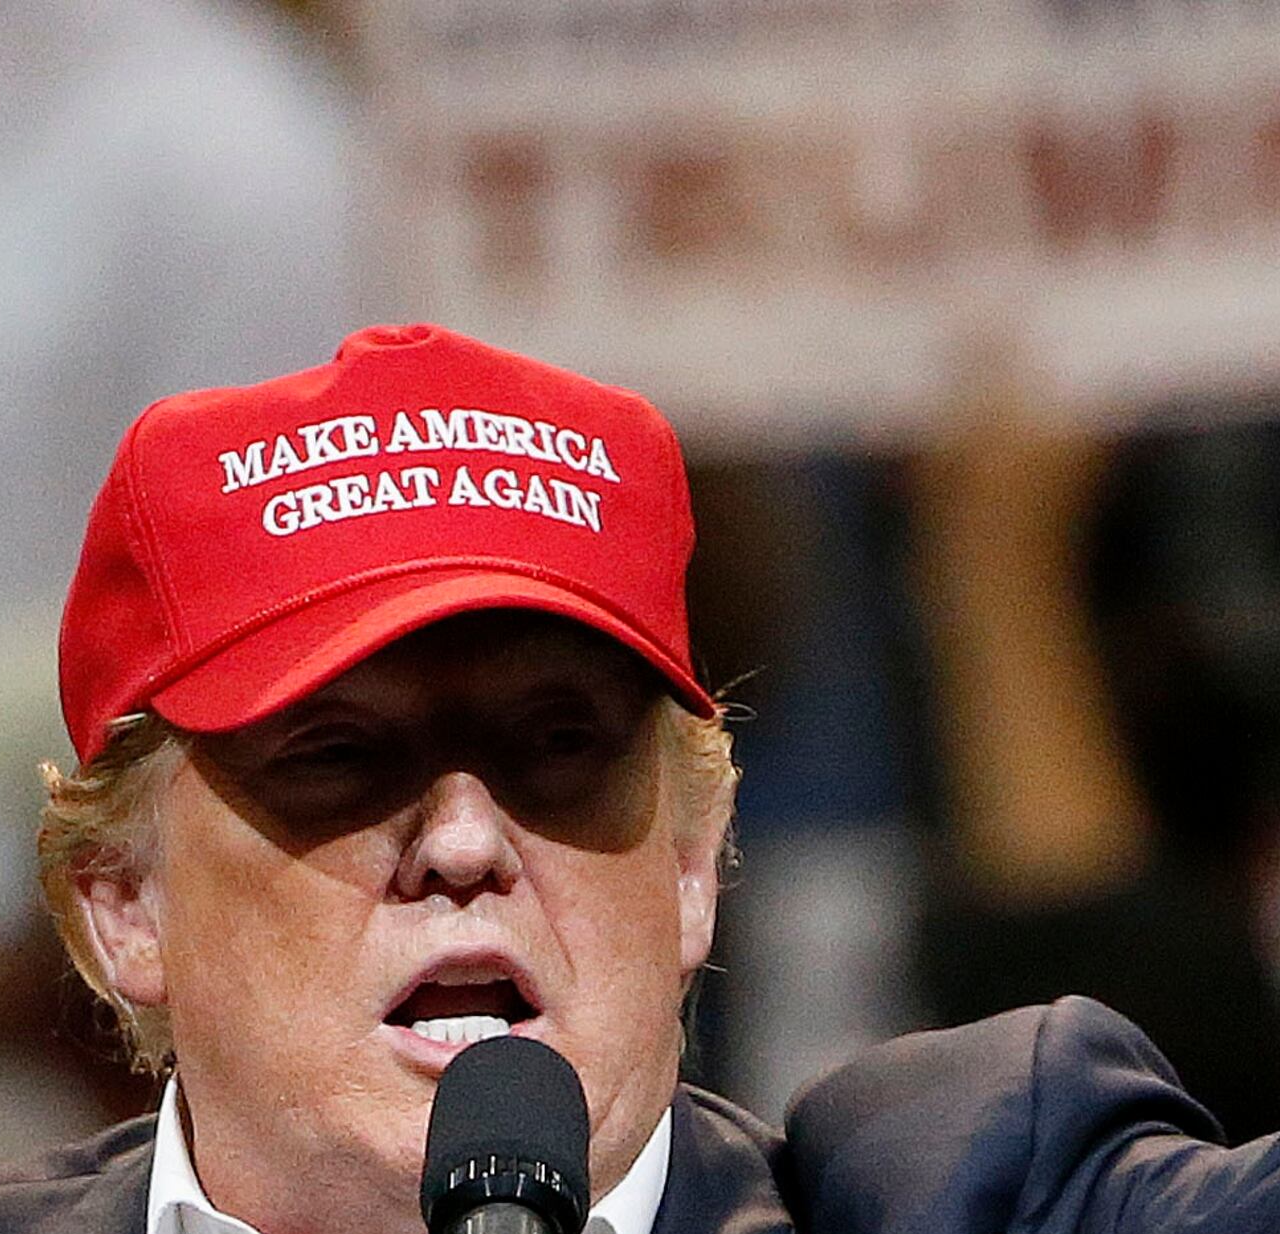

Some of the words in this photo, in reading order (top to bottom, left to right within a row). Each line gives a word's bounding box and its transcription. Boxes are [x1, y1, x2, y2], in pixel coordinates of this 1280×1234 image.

[218, 414, 380, 494] MAKE
[384, 408, 621, 484] AMERICA
[261, 465, 440, 537] GREAT
[448, 465, 602, 533] AGAIN
